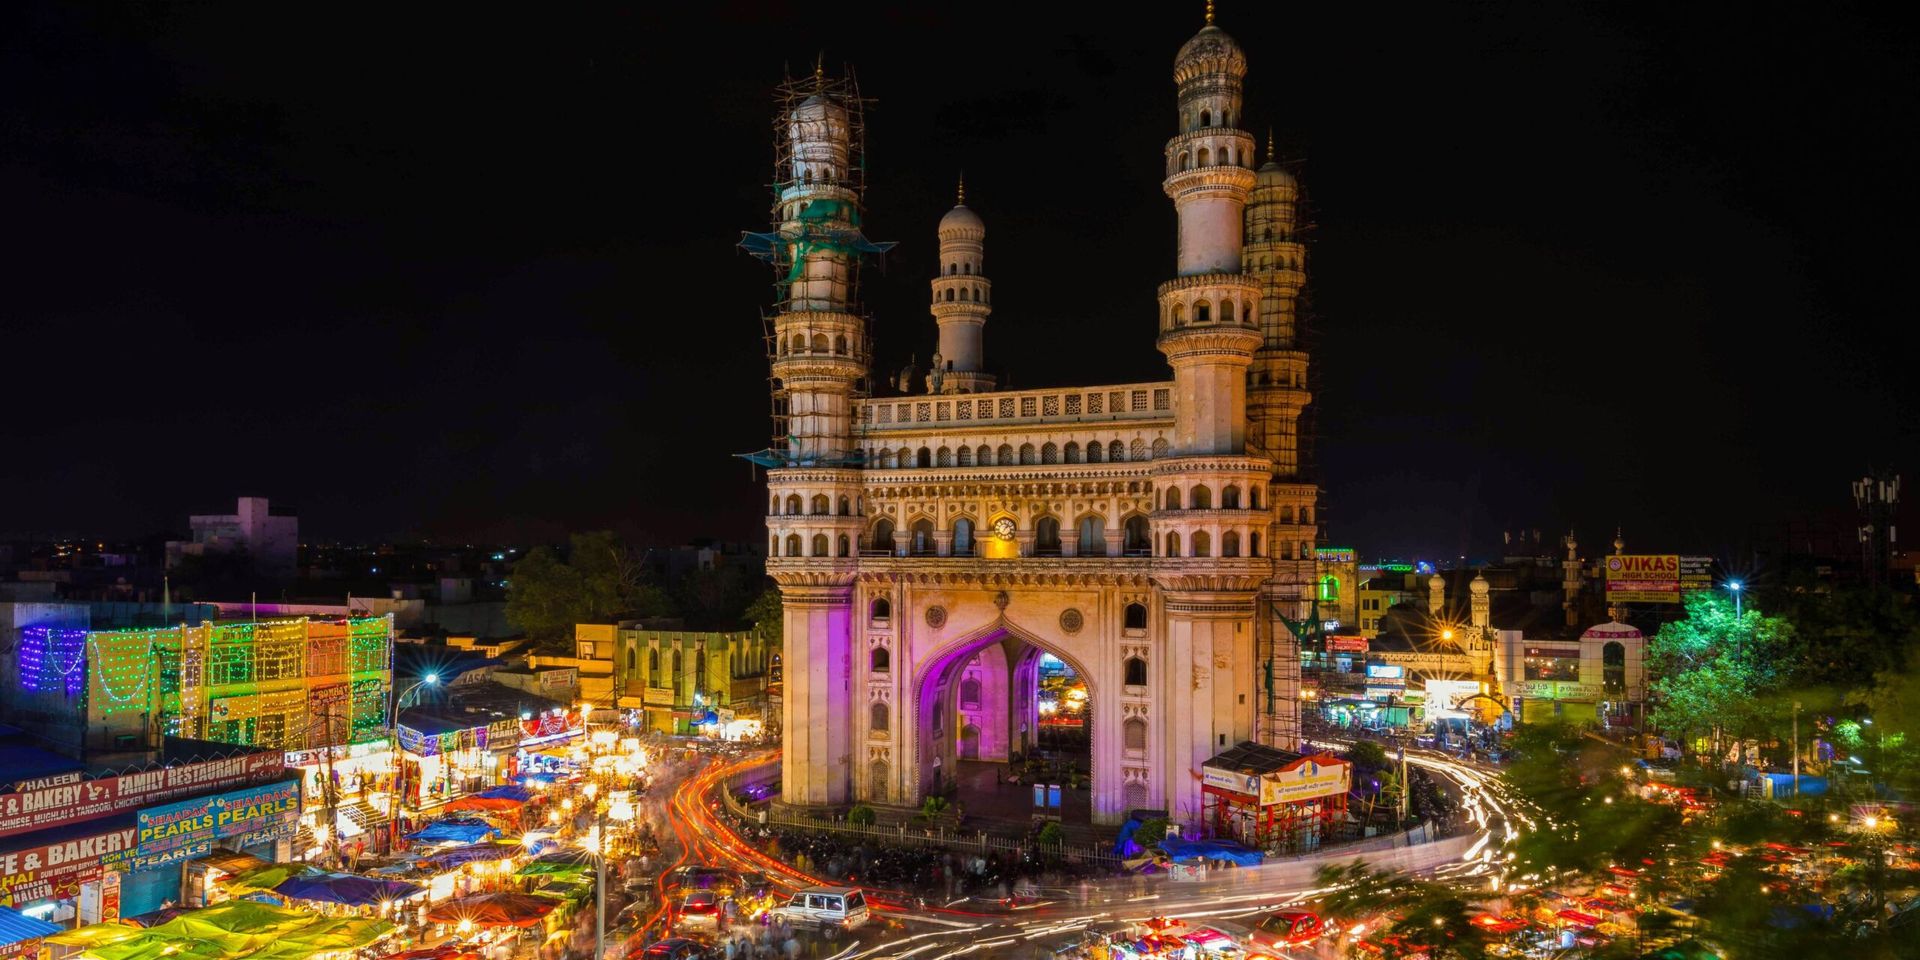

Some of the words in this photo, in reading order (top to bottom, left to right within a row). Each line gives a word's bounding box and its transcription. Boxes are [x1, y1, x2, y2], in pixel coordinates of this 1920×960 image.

[1622, 557, 1678, 571] VIKAS
[490, 728, 519, 739] PEARLS
[7, 799, 19, 816] &
[22, 785, 82, 813] BAKERY
[118, 767, 165, 796] FAMILY
[168, 756, 248, 787] RESTAURANT
[26, 773, 80, 791] HALEEM
[34, 809, 68, 824] MUGHLAI
[69, 808, 75, 818] &
[146, 791, 173, 804] MUTTON
[223, 789, 292, 811] SHAADAN
[148, 806, 208, 827] SHAADAN
[218, 797, 298, 826] PEARLS
[141, 814, 214, 842] PEARLS
[244, 822, 297, 843] PEARLS
[24, 853, 41, 871] &
[48, 829, 135, 867] BAKERY
[101, 852, 121, 864] NON
[134, 844, 208, 869] PEARLS
[41, 868, 54, 880] DUM
[55, 863, 77, 877] MUTTON
[14, 885, 53, 903] HALEEM
